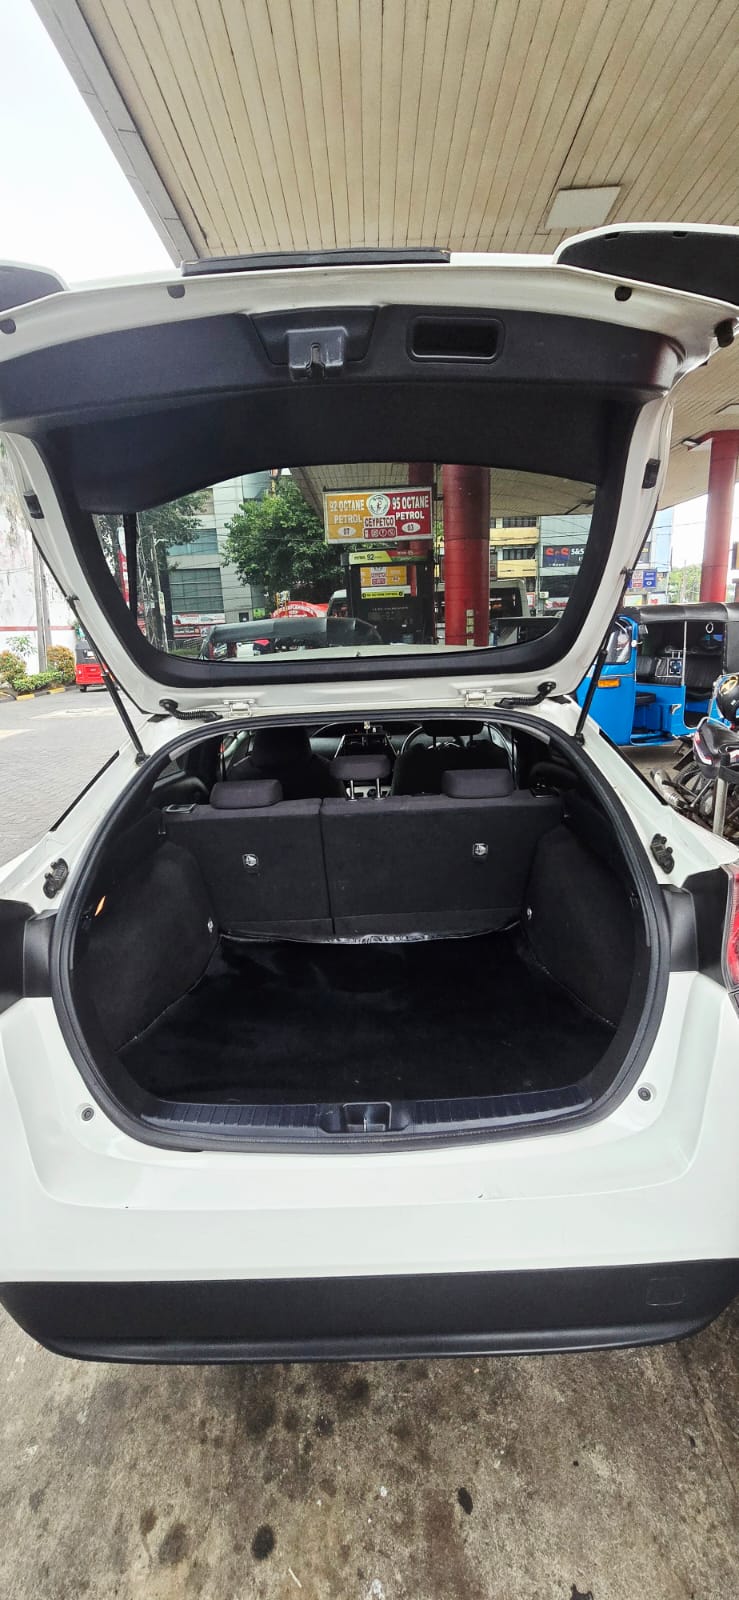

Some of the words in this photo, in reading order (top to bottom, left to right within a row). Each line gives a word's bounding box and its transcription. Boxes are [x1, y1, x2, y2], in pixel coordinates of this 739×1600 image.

[338, 499, 365, 511] OCTANE
[392, 497, 401, 510] 95
[401, 495, 429, 510] OCTANE
[334, 514, 362, 524] PETROL
[396, 511, 425, 520] PETROL
[364, 516, 394, 528] CEYPETCO
